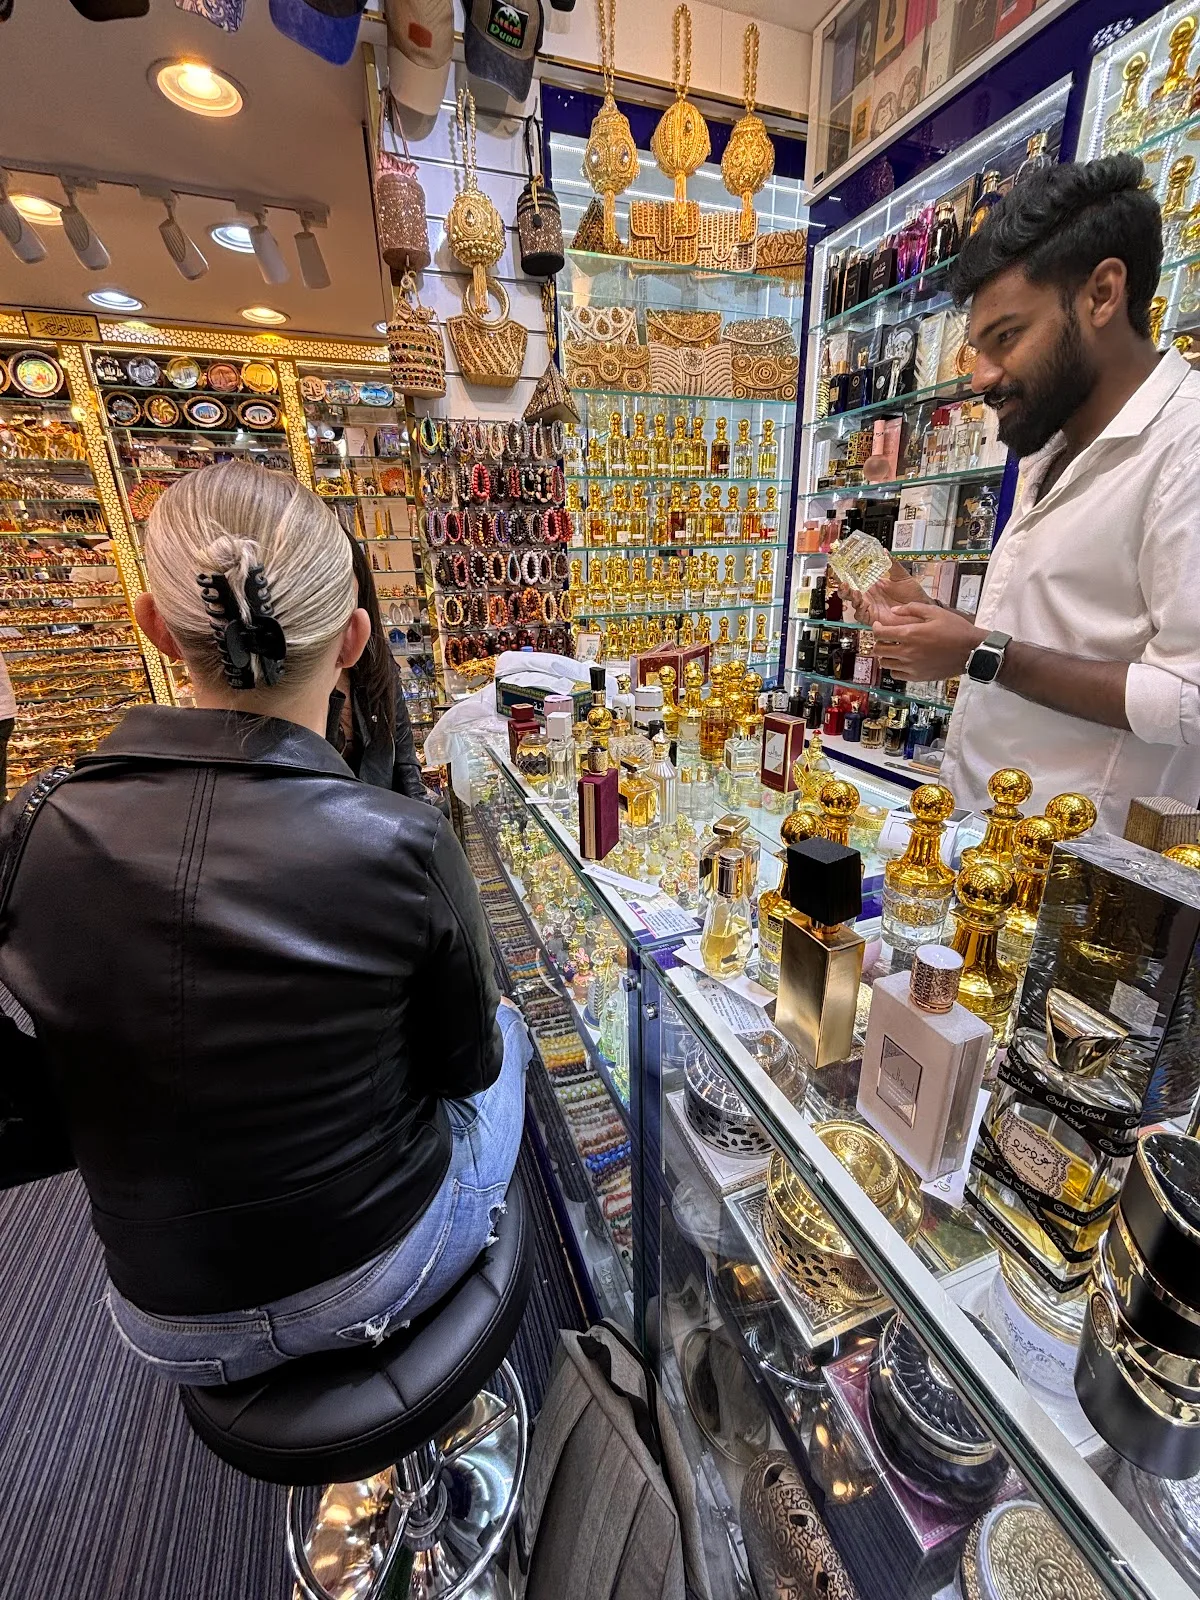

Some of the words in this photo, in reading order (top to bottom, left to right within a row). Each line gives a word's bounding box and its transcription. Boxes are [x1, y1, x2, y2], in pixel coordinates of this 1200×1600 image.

[1010, 1075, 1035, 1094] Mood
[1045, 1094, 1068, 1109] Oud
[1069, 1105, 1108, 1122] Mood
[1007, 1146, 1023, 1161] Oud
[1023, 1161, 1049, 1183] Mood
[995, 1170, 1013, 1185] Oud
[1013, 1182, 1040, 1202] Mood
[1053, 1203, 1075, 1219] Oud
[976, 1203, 992, 1222] Oud
[994, 1221, 1020, 1247] Mood
[1029, 1256, 1049, 1278] Oud
